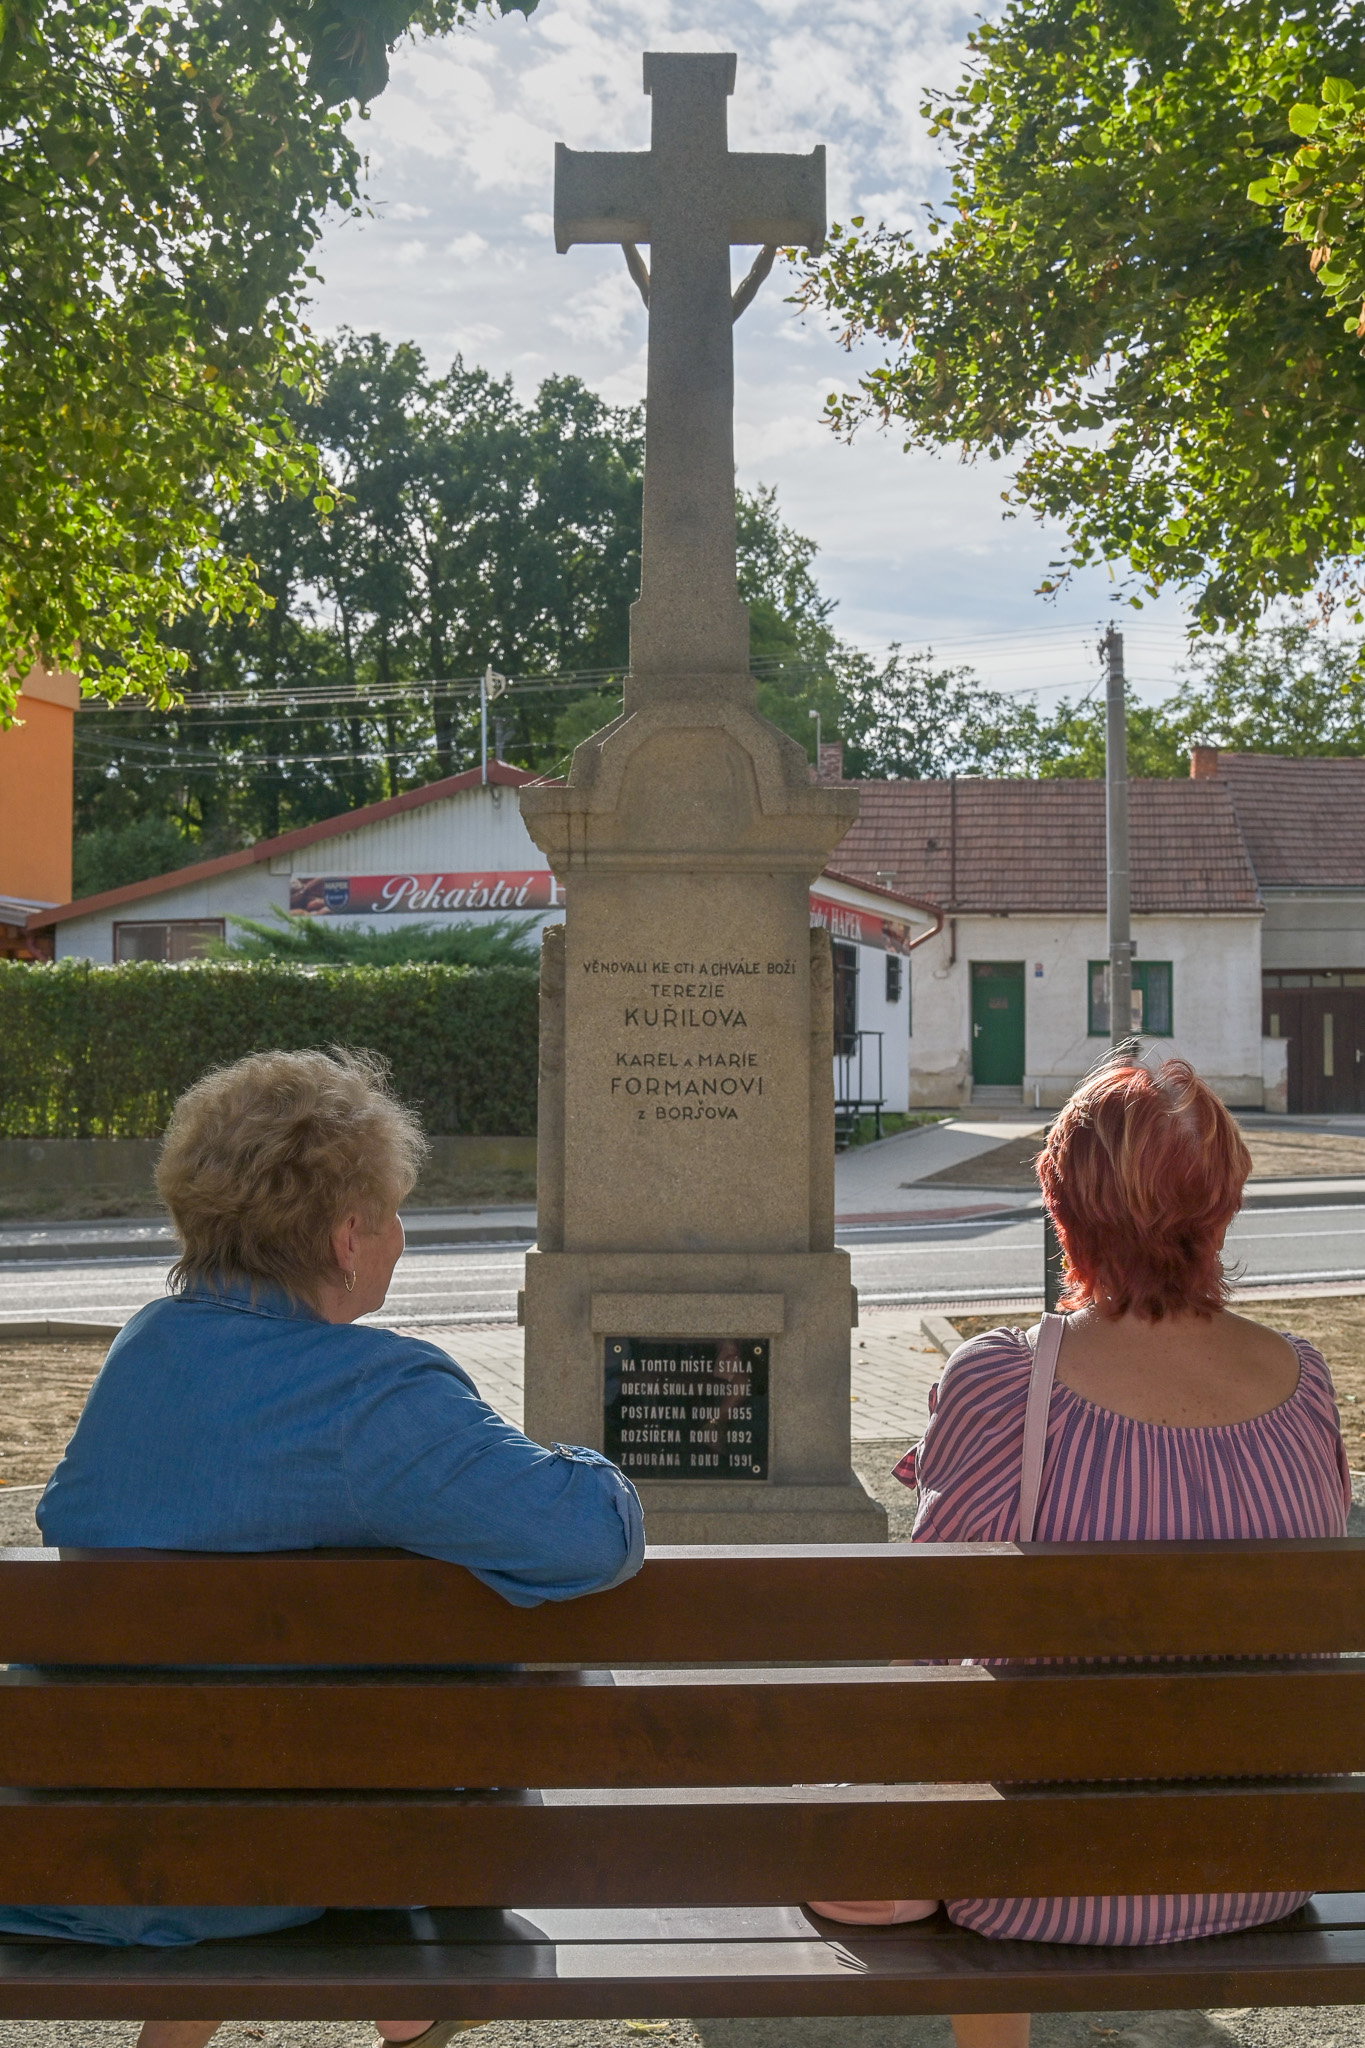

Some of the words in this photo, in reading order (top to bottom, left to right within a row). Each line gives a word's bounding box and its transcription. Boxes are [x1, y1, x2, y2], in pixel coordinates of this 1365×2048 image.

[372, 875, 534, 913] Pekařství
[583, 959, 647, 974] VĚNOVALI
[653, 962, 670, 974] KE
[674, 962, 694, 974] CTI
[700, 963, 708, 974] A
[711, 958, 760, 975] CHVÁLE
[767, 959, 796, 974] BOŽÍ
[651, 984, 725, 998] TEREZIE
[626, 1004, 748, 1027] KUŘILOVA
[617, 1053, 678, 1067] KAREL
[698, 1053, 758, 1067] MARIE
[611, 1077, 763, 1096] FORMANOVI
[656, 1101, 738, 1120] BORŠOVA
[621, 1359, 635, 1372] NA
[640, 1359, 676, 1372] TOMTO
[718, 1356, 753, 1373] STÁLA
[621, 1378, 660, 1395] OBECNÁ
[663, 1377, 694, 1396] ŠKOLA
[697, 1383, 704, 1396] V
[621, 1406, 686, 1419] POSTAVENA
[692, 1407, 720, 1420] ROKU
[728, 1407, 752, 1420] 1855
[621, 1424, 681, 1443] ROZŠÍŘENA
[690, 1430, 718, 1443] ROKU
[727, 1430, 752, 1443] 1892
[621, 1448, 681, 1466] ZBOURÁNA
[691, 1454, 719, 1466] ROKU
[729, 1454, 752, 1467] 1991
